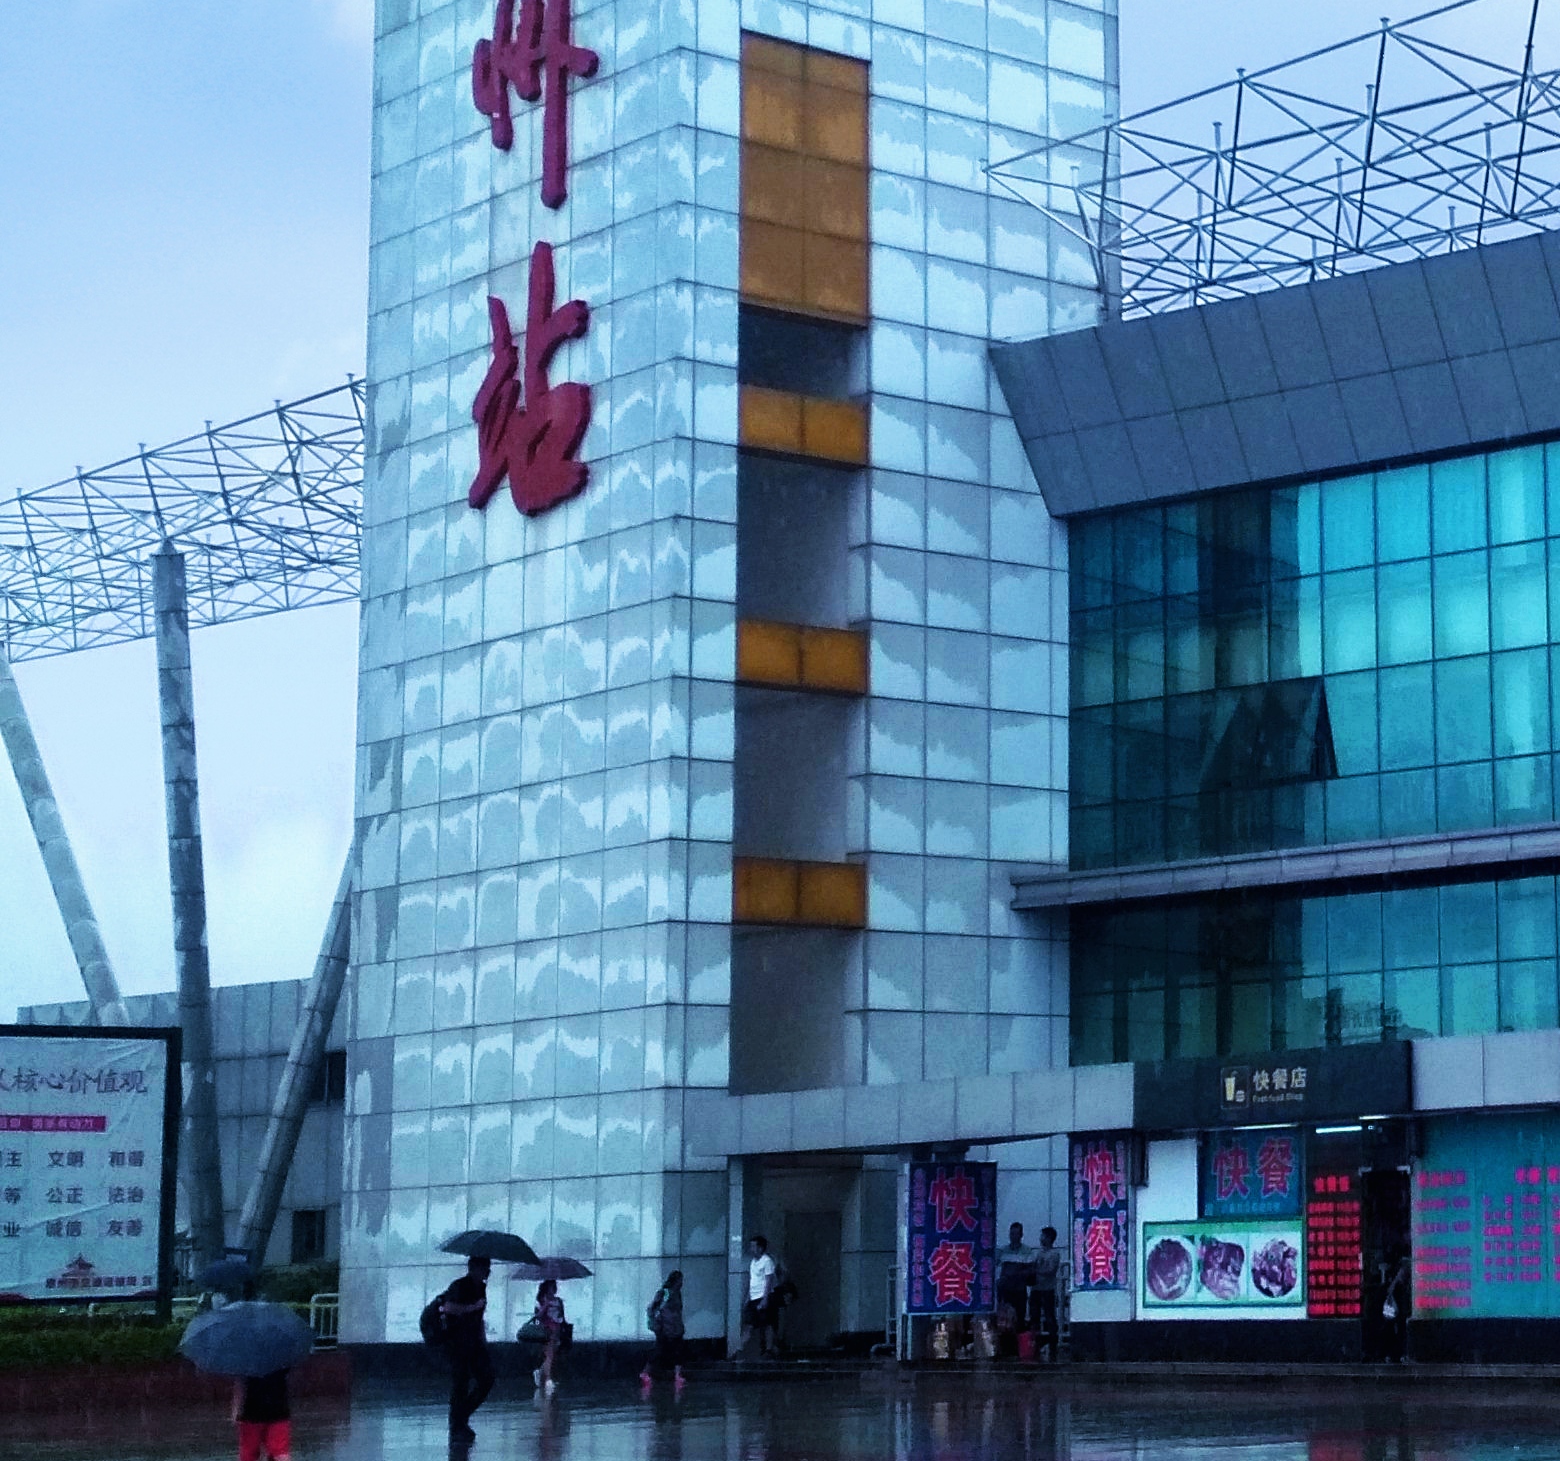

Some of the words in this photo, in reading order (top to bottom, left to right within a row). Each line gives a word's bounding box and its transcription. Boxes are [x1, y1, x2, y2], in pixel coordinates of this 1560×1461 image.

[1253, 1066, 1307, 1091] 快餐店
[1084, 1140, 1117, 1286] 快餐
[1211, 1137, 1295, 1201] 快餐
[928, 1166, 979, 1308] 快餐
